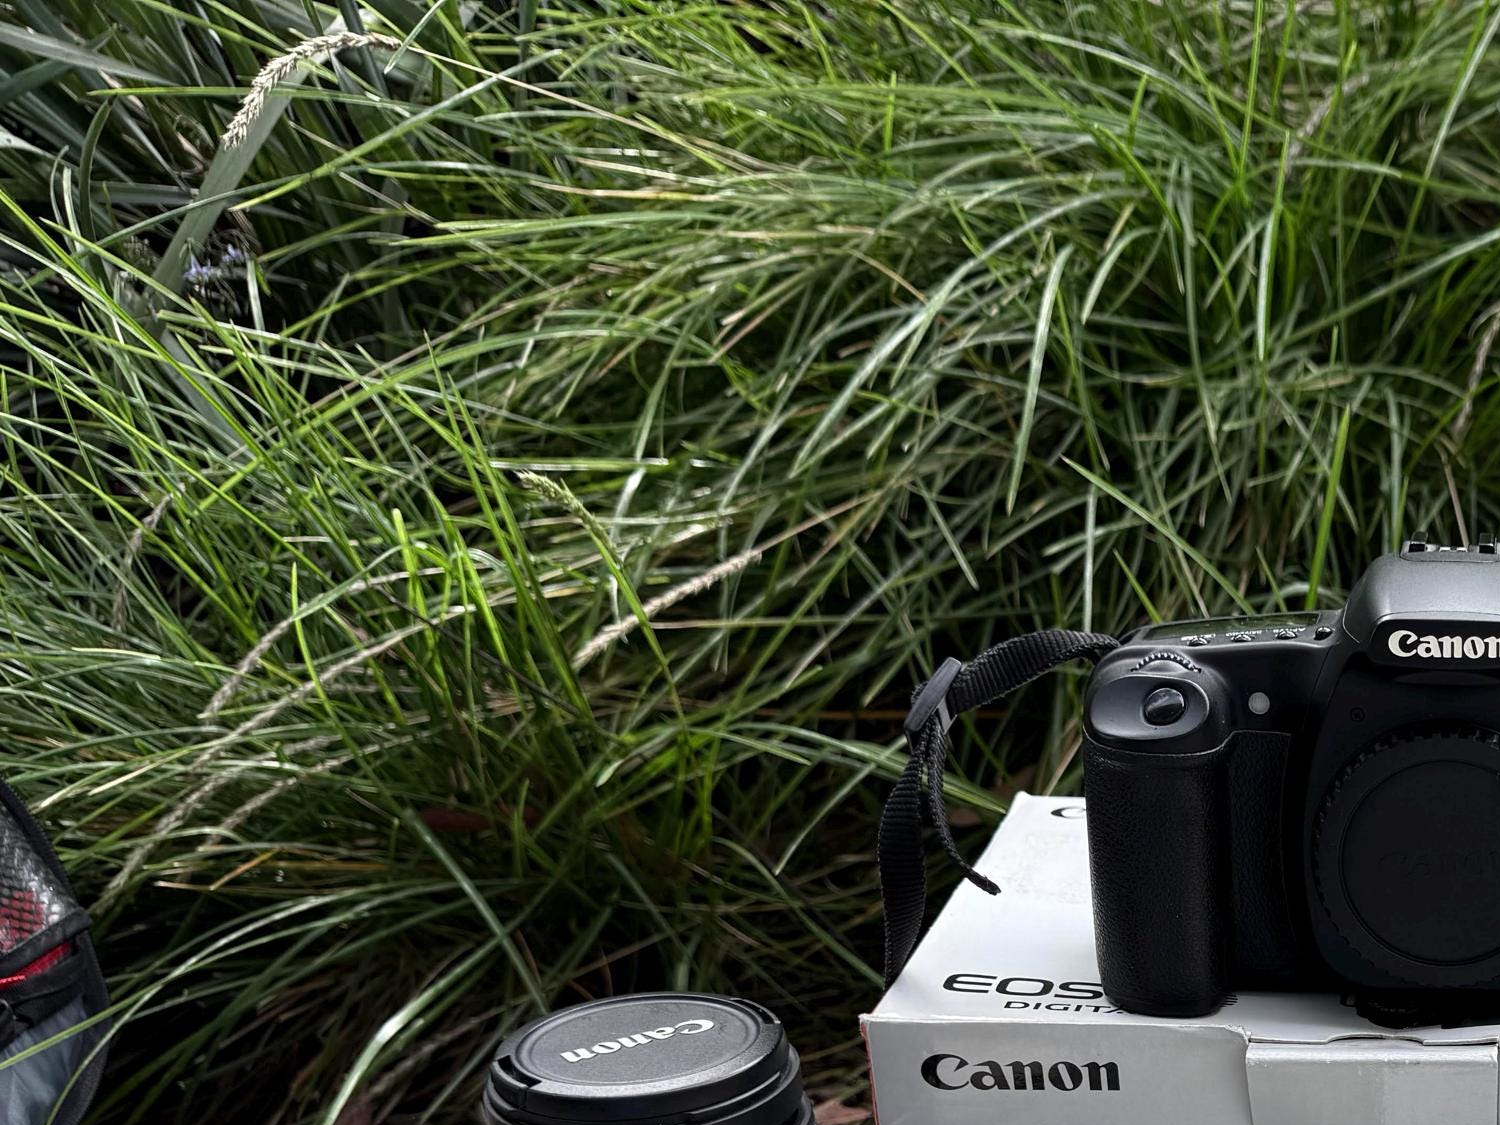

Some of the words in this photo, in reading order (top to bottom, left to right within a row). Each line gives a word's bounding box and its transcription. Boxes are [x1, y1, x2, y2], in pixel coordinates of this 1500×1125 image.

[943, 974, 1104, 999] EOS
[560, 1019, 715, 1063] Canon
[921, 1053, 1121, 1091] Canon
